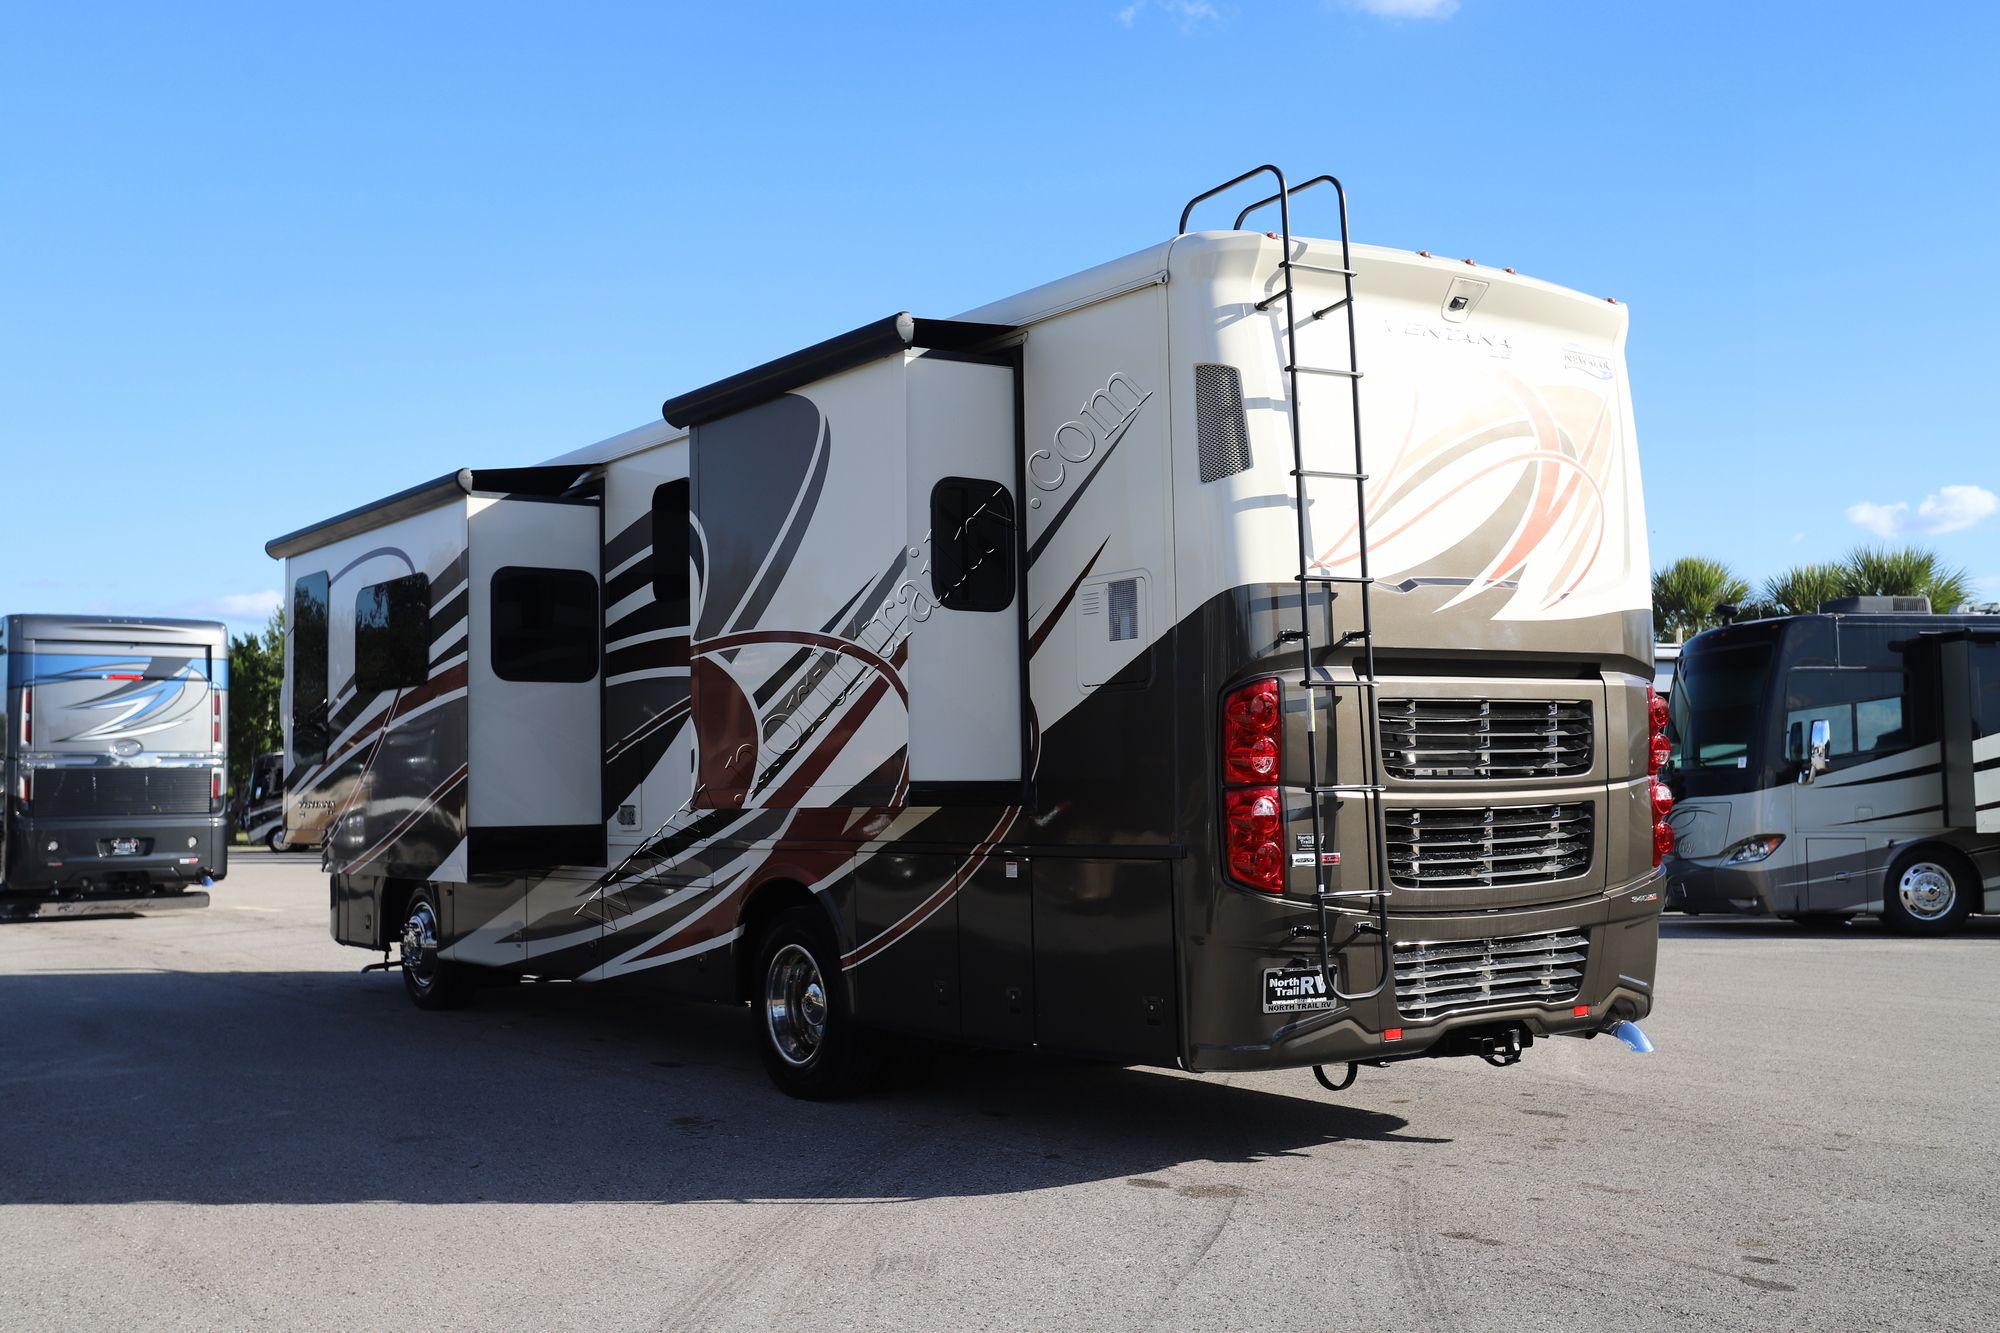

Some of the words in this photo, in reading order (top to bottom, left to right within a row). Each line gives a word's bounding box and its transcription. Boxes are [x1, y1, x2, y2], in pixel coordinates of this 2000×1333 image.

[1385, 320, 1512, 349] VENTANA
[1269, 977, 1299, 988] North
[1275, 986, 1299, 997] Trail
[1300, 974, 1327, 995] RV
[1268, 1002, 1294, 1012] NORTH
[1297, 1001, 1319, 1010] TRAIL
[1321, 1001, 1332, 1009] RV
